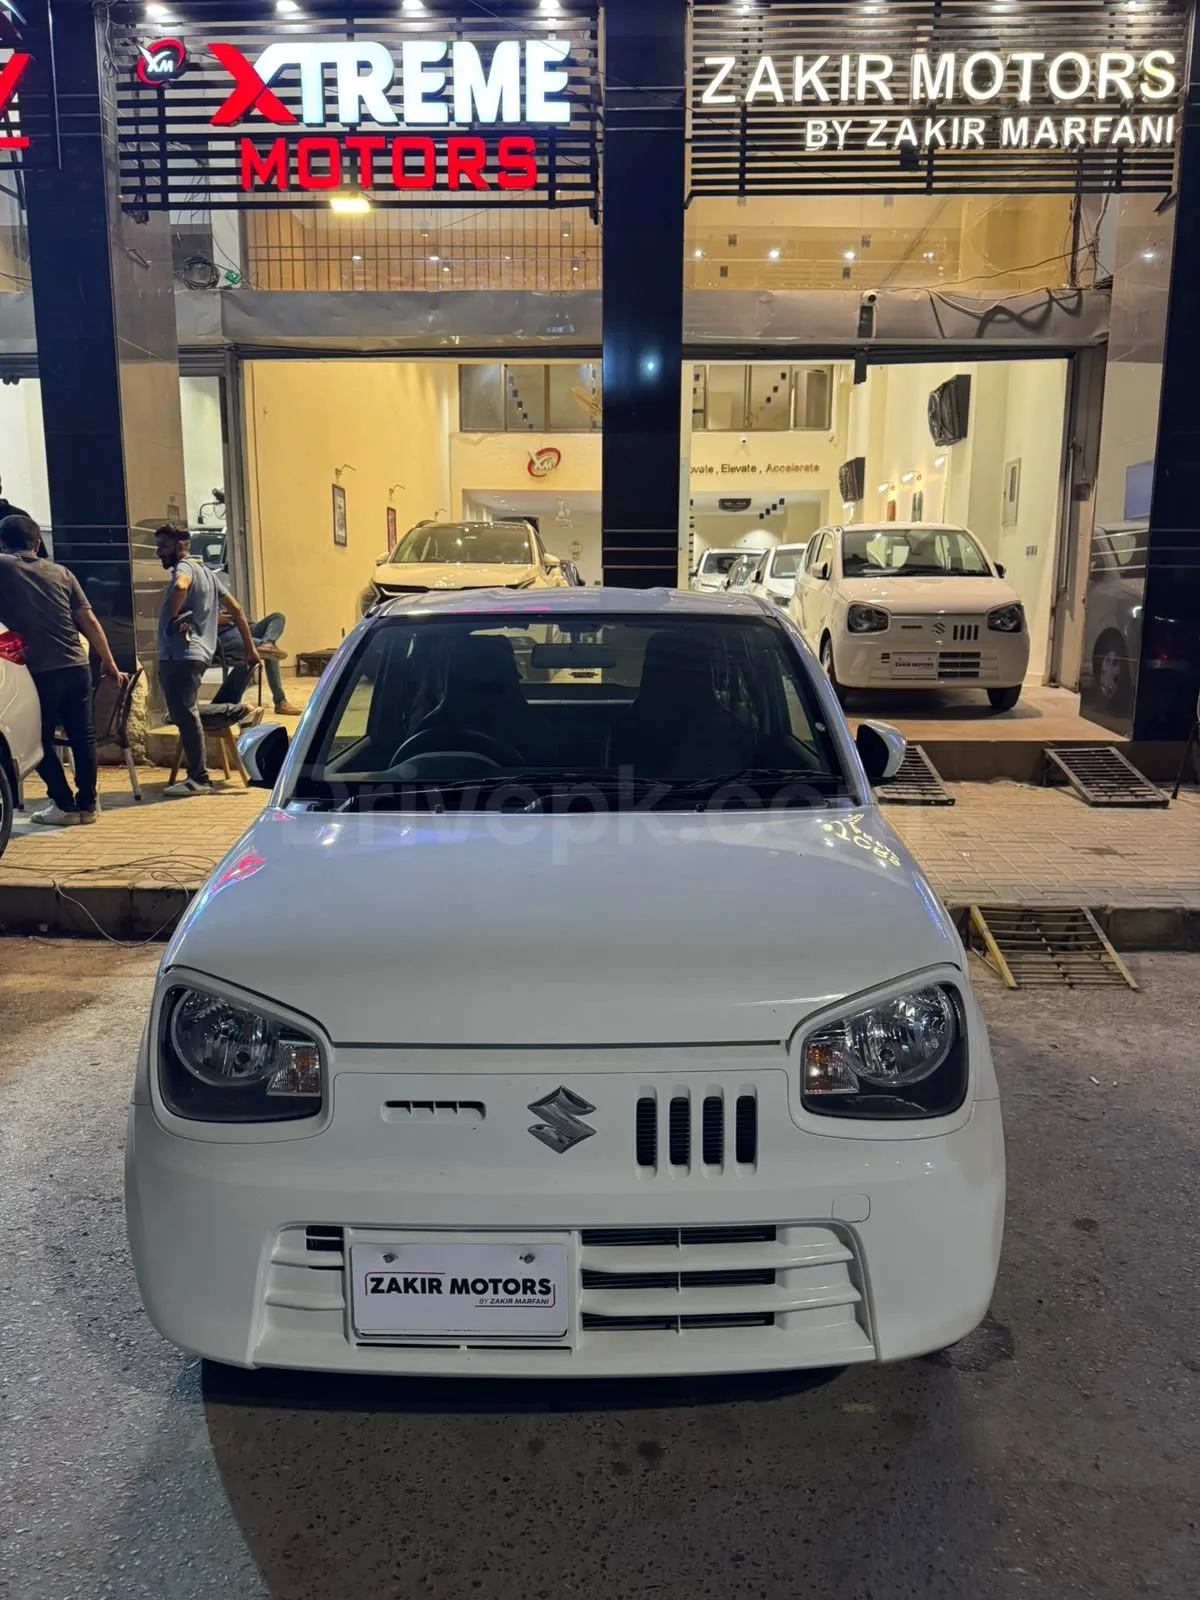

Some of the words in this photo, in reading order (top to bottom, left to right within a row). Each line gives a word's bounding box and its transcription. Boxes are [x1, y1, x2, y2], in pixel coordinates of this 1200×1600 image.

[206, 40, 572, 125] XTREME
[702, 54, 894, 103] ZAKIR
[911, 50, 1176, 102] MOTORS
[805, 119, 852, 149] BY
[866, 117, 986, 147] ZAKIR
[1002, 115, 1175, 147] MARFANI
[240, 136, 538, 190] MOTORS
[766, 463, 820, 474] Accelerate
[370, 1276, 443, 1295] ZAKIR
[449, 1277, 552, 1296] MOTORS
[479, 1297, 489, 1305] BY
[490, 1297, 513, 1305] ZAKIR
[514, 1297, 549, 1305] MARFANI
